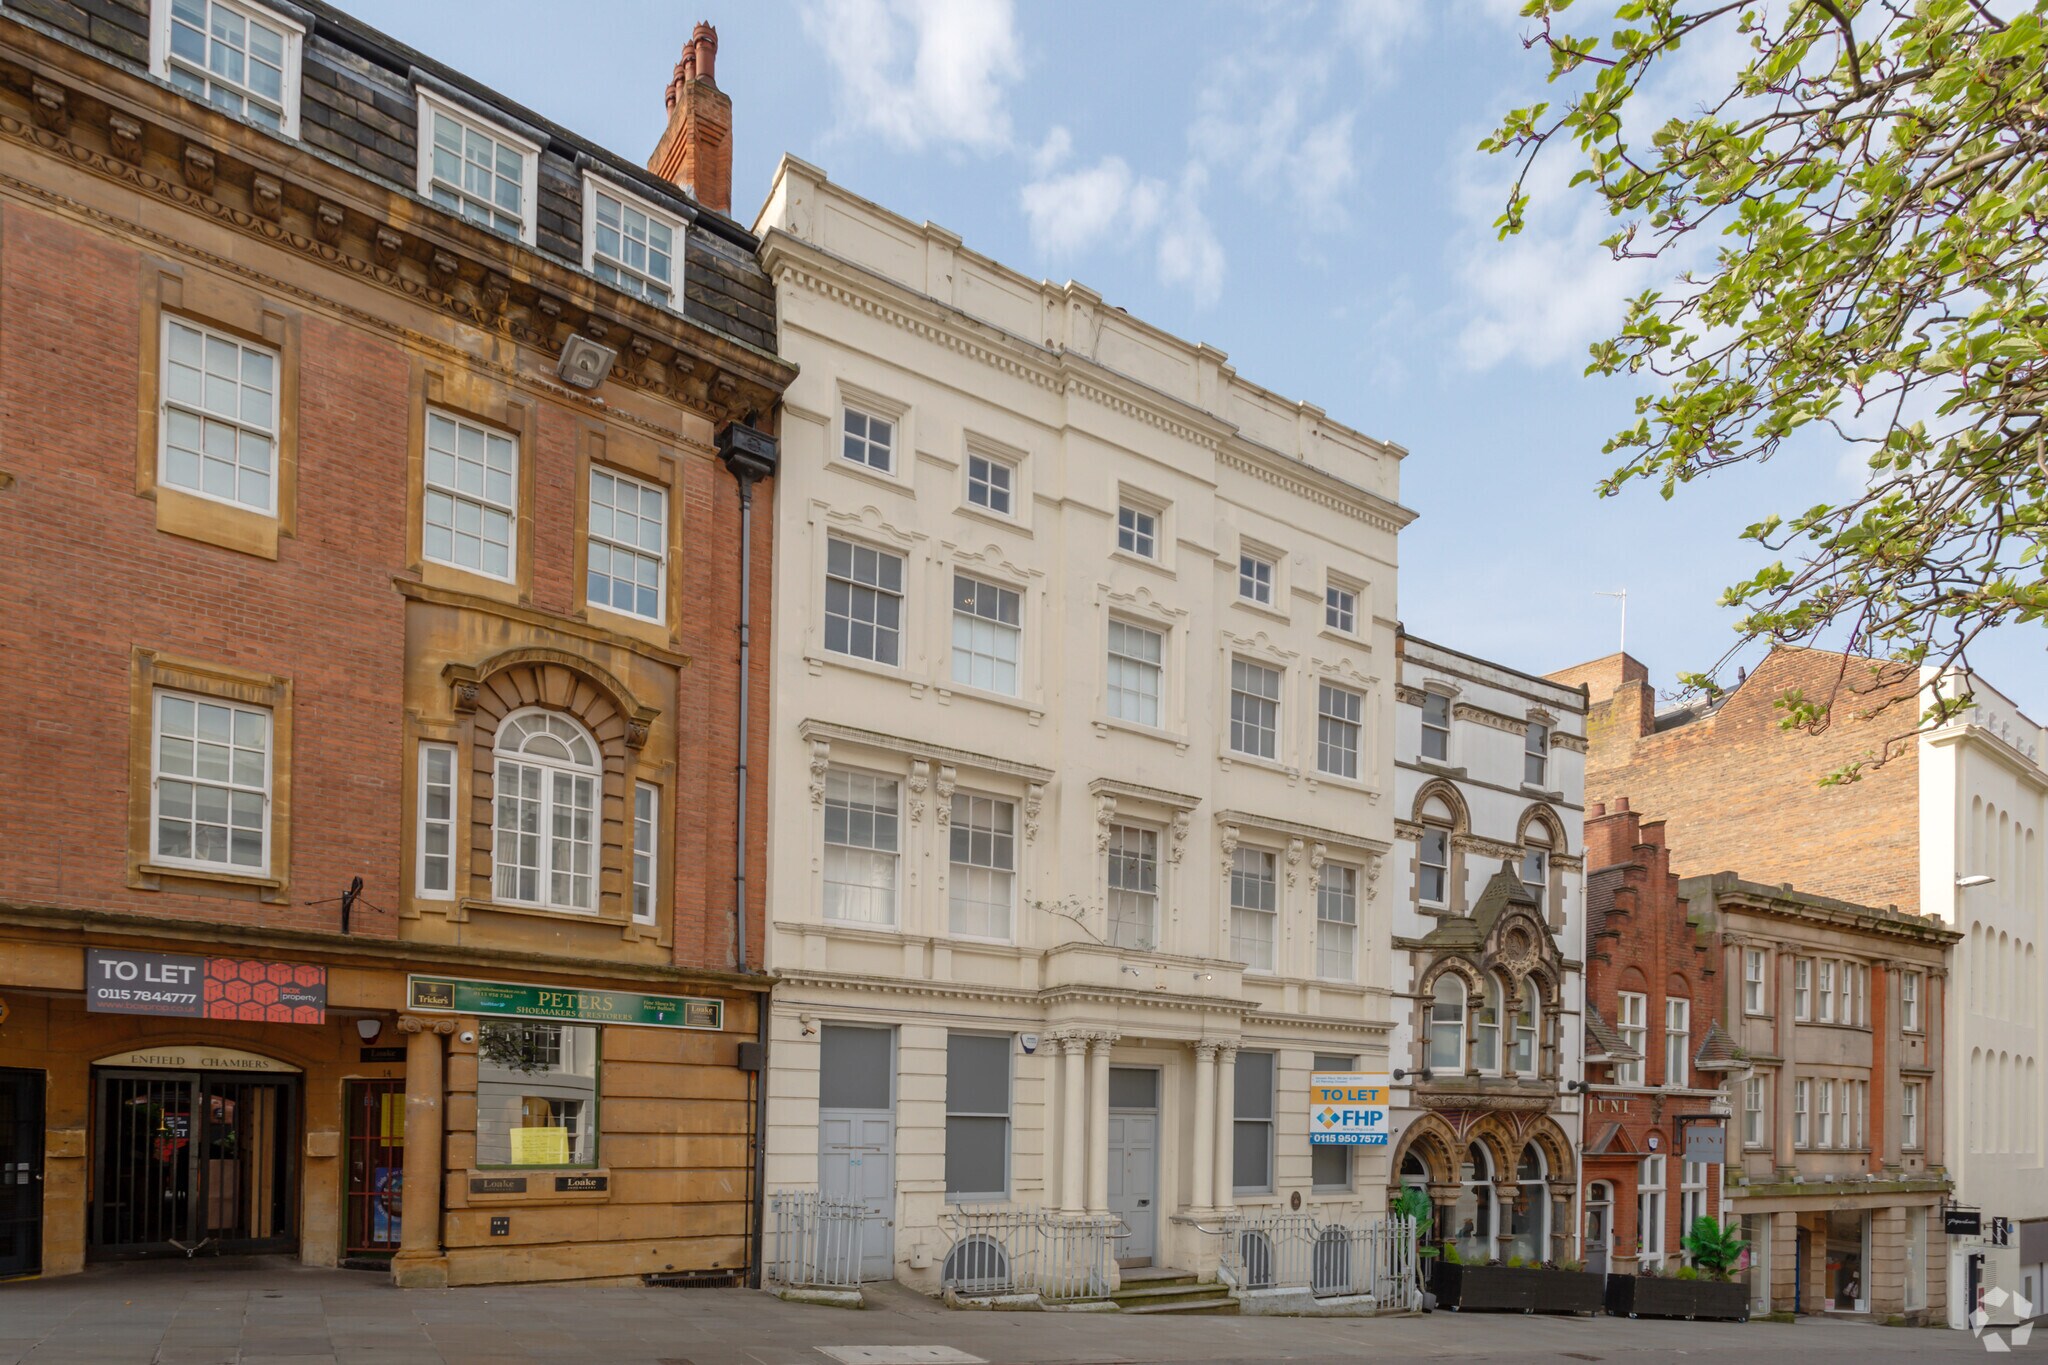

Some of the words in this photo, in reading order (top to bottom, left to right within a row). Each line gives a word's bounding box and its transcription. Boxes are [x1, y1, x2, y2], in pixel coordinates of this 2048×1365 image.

[98, 959, 138, 981] TO
[145, 963, 196, 985] LET
[97, 988, 131, 1000] 0115
[133, 990, 197, 1004] 7844777
[282, 993, 317, 1002] property
[418, 994, 449, 1004] Tricker's
[538, 991, 614, 1012] PETERS
[96, 1001, 196, 1013] www.boxprop.co.uk
[691, 1005, 713, 1013] Loake
[516, 1006, 576, 1018] SHOEMAKERS
[577, 1010, 584, 1018] &
[586, 1011, 633, 1021] RESTORERS
[131, 1055, 185, 1065] ENFIELD
[201, 1058, 269, 1068] CHAMBERS
[383, 1069, 392, 1077] 14
[1320, 1089, 1343, 1101] TO
[1347, 1089, 1379, 1101] LET
[1588, 1099, 1629, 1116] JUNI
[1342, 1110, 1383, 1126] FHP
[1314, 1134, 1336, 1143] 0115
[1338, 1134, 1358, 1143] 950
[1359, 1135, 1384, 1143] 7577
[484, 1180, 514, 1188] Loake
[567, 1178, 597, 1186] Loake
